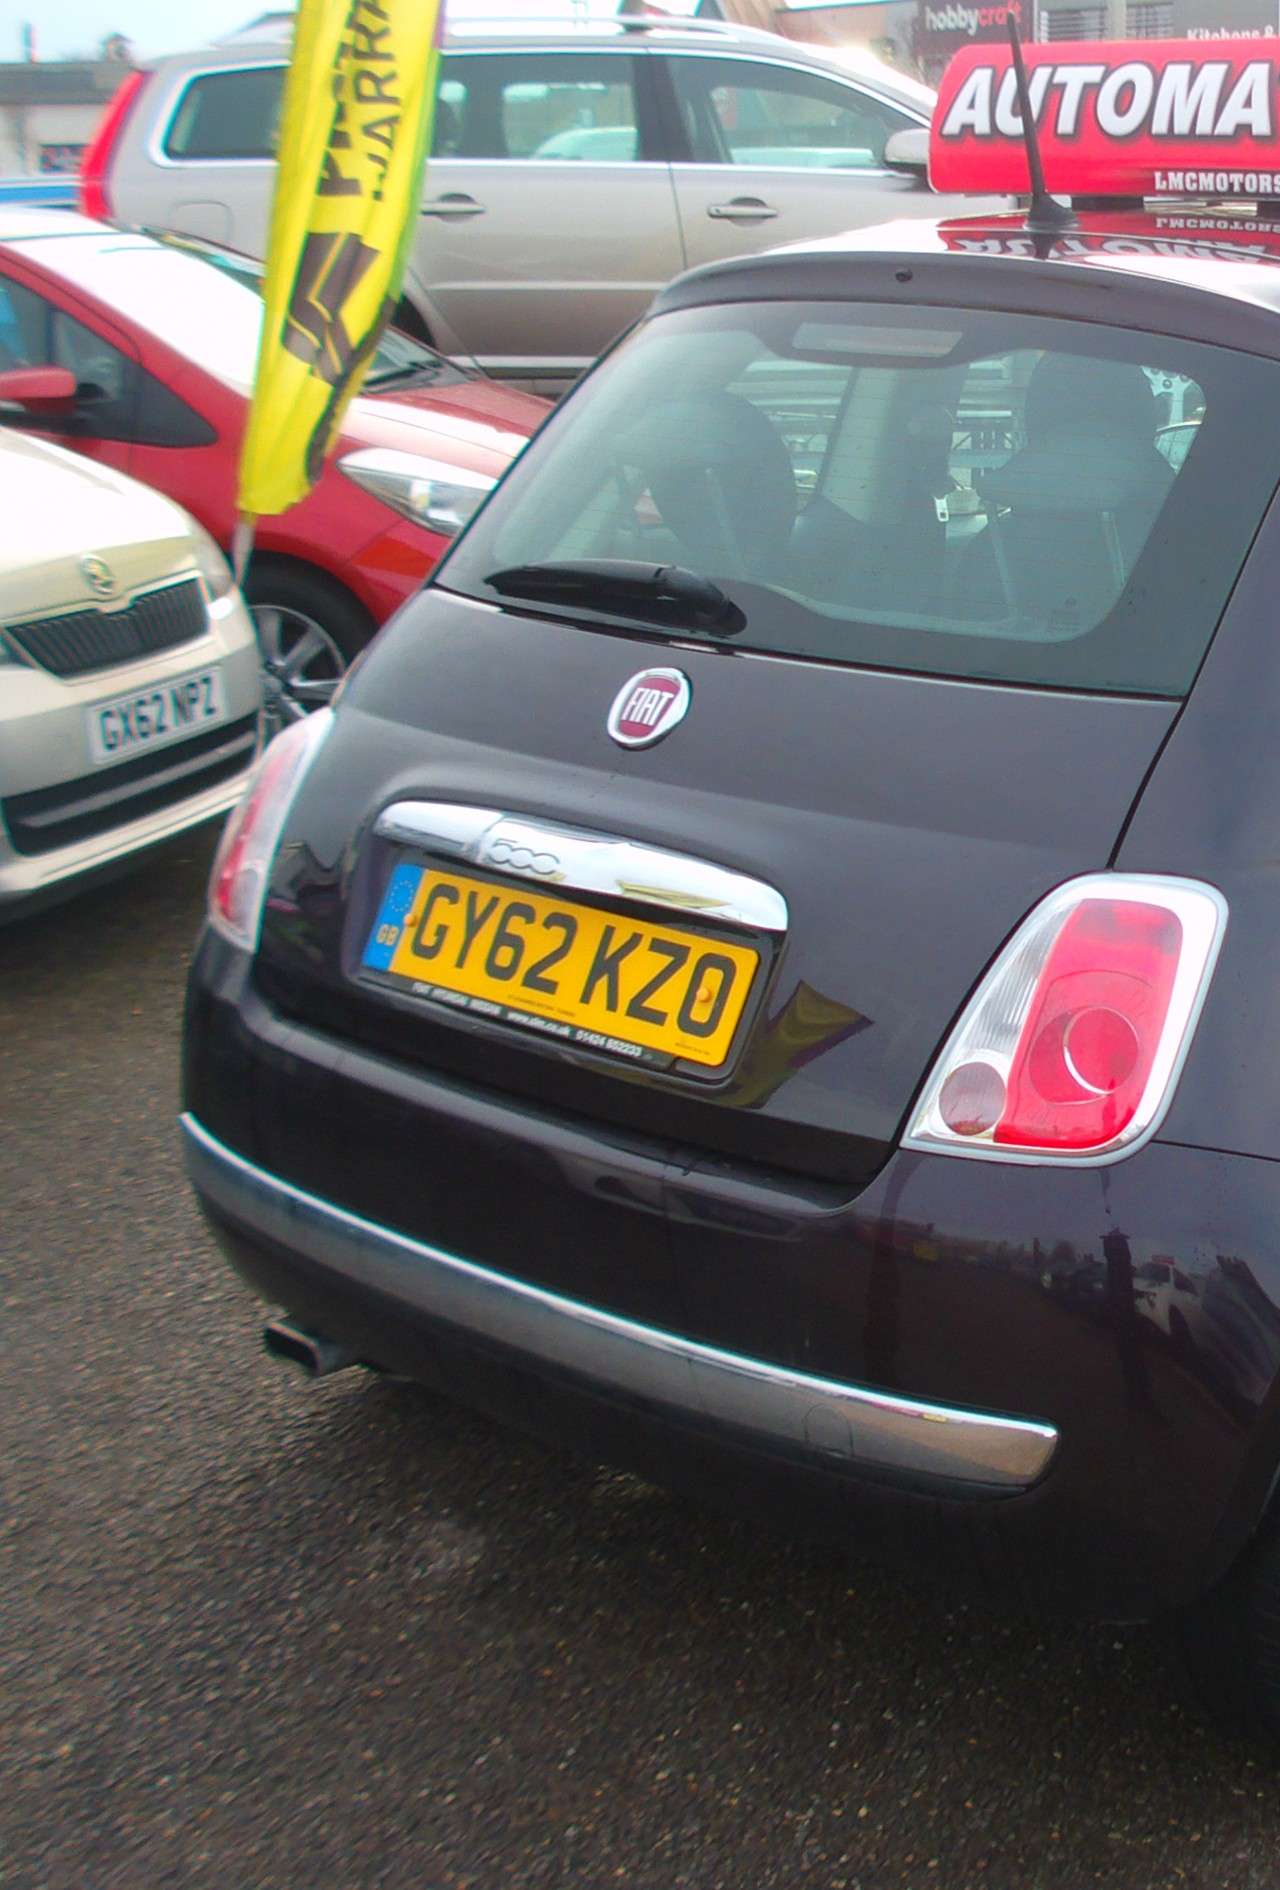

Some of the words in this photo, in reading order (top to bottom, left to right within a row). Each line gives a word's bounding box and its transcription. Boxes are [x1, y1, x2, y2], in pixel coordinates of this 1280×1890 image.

[100, 693, 166, 751] GX62
[621, 687, 675, 727] FIAT
[410, 883, 578, 996] GY62
